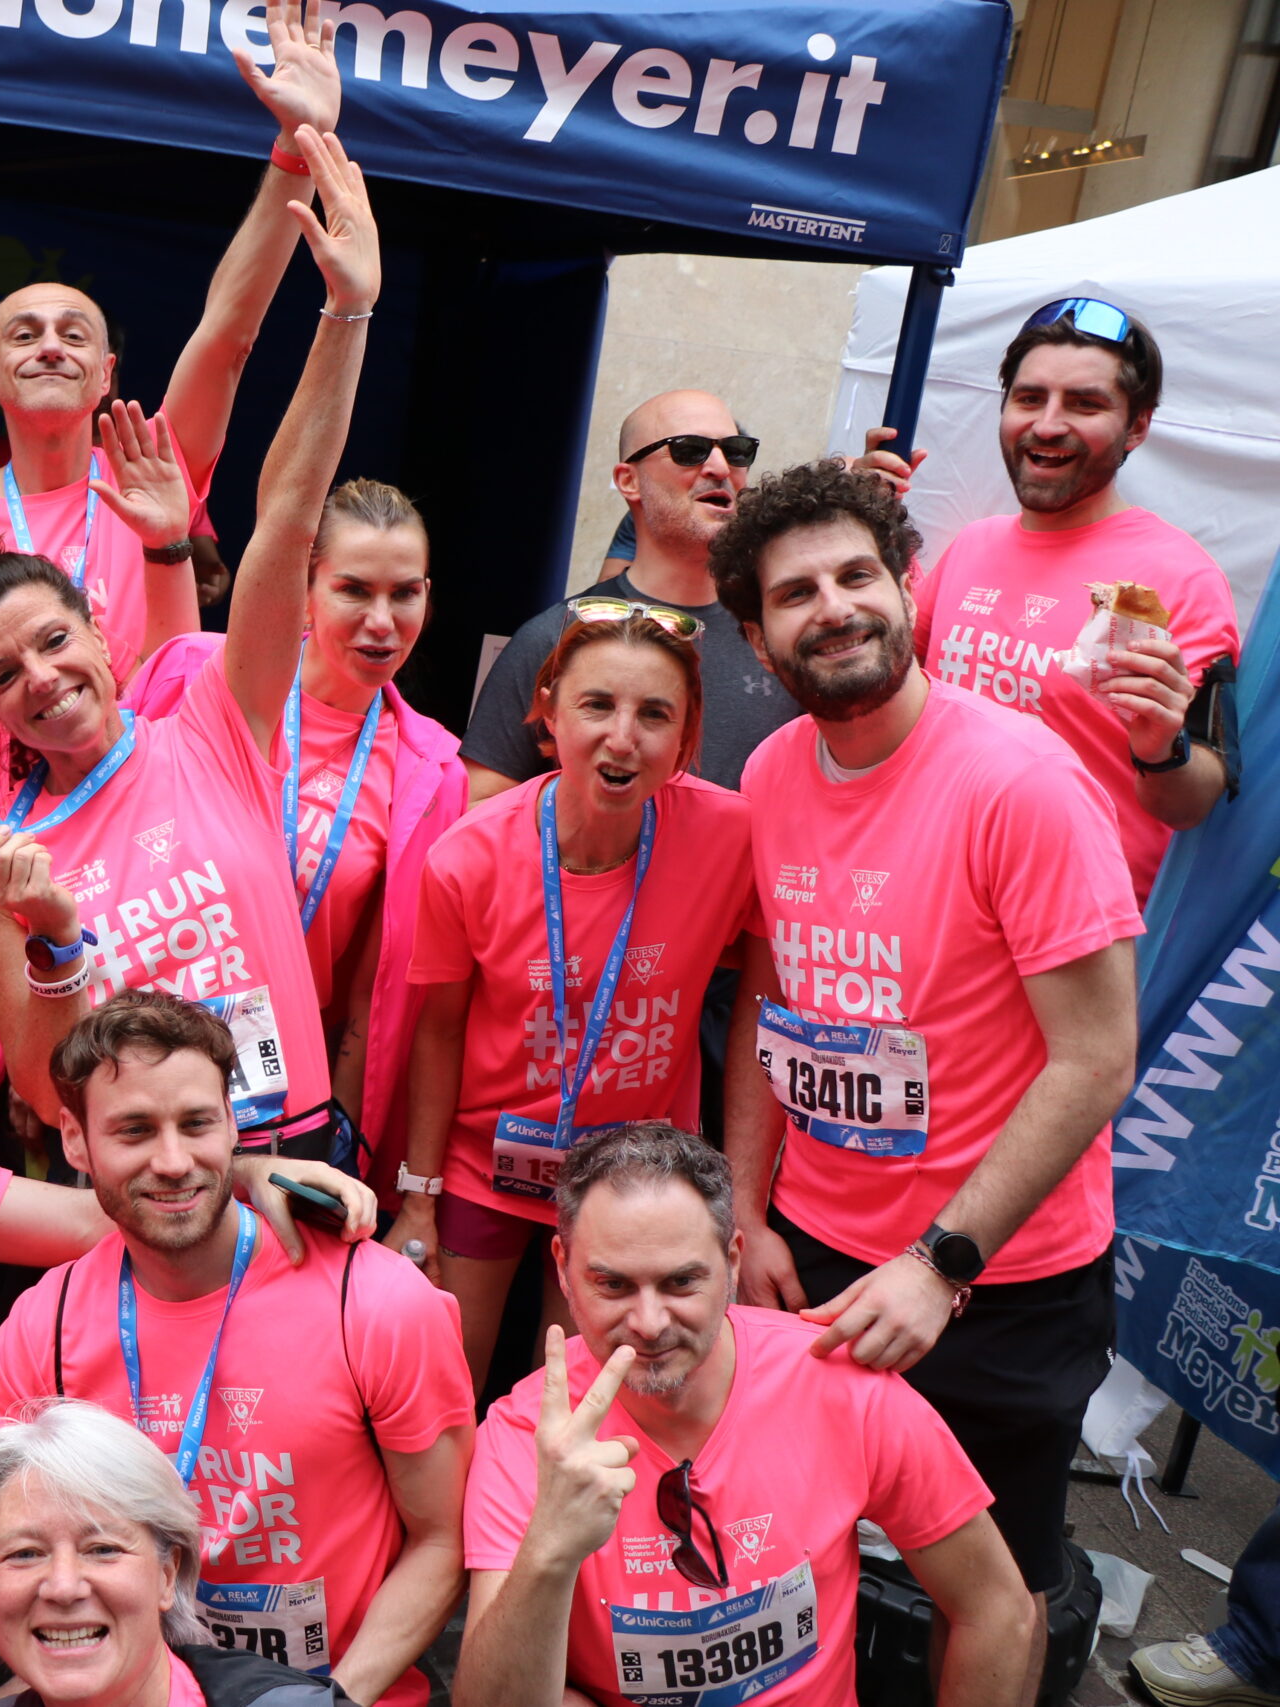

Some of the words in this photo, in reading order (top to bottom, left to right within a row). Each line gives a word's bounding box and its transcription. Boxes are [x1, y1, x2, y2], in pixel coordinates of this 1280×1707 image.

[958, 600, 994, 615] Meyer
[1027, 595, 1053, 608] GUESS
[972, 662, 1043, 711] FOR
[286, 785, 295, 815] EDITION
[137, 823, 174, 846] GUESS
[74, 878, 112, 903] eyer
[855, 873, 884, 885] GUESS
[773, 884, 816, 904] Meyer
[135, 902, 239, 977] FOR
[552, 927, 560, 956] UniCredit
[626, 947, 660, 961] GUESS
[152, 945, 252, 1001] YER
[529, 977, 583, 991] Meer
[597, 987, 610, 1015] UniCredit
[812, 966, 905, 1020] FOR
[772, 1011, 805, 1037] UniCredit
[831, 1031, 860, 1041] RELAY
[580, 1038, 595, 1068] EDITION
[888, 1046, 918, 1056] Meyer
[787, 1057, 883, 1124] 1341C
[236, 1111, 258, 1120] MILANO
[517, 1126, 556, 1141] UniCred
[513, 1182, 542, 1194] asics
[1187, 1258, 1249, 1318] Fondazione
[121, 1288, 130, 1320] UniCredit
[1182, 1279, 1229, 1327] Ospedale
[1176, 1296, 1228, 1349] Pediatrico
[1158, 1312, 1278, 1434] Meyer
[223, 1390, 257, 1402] GUESS
[192, 1391, 208, 1429] EDITION
[192, 1445, 296, 1491] RUN
[208, 1484, 302, 1535] FOR
[730, 1519, 768, 1537] GUESS
[200, 1530, 303, 1566] YER
[625, 1559, 676, 1576] Meye
[228, 1590, 258, 1599] RELAY
[288, 1594, 316, 1607] Meyer
[782, 1580, 806, 1597] Meyer
[726, 1596, 755, 1611] RELAY
[637, 1615, 693, 1628] UniCredit
[210, 1622, 289, 1667] 37B
[657, 1620, 784, 1689] 1338B
[648, 1696, 683, 1705] asics
